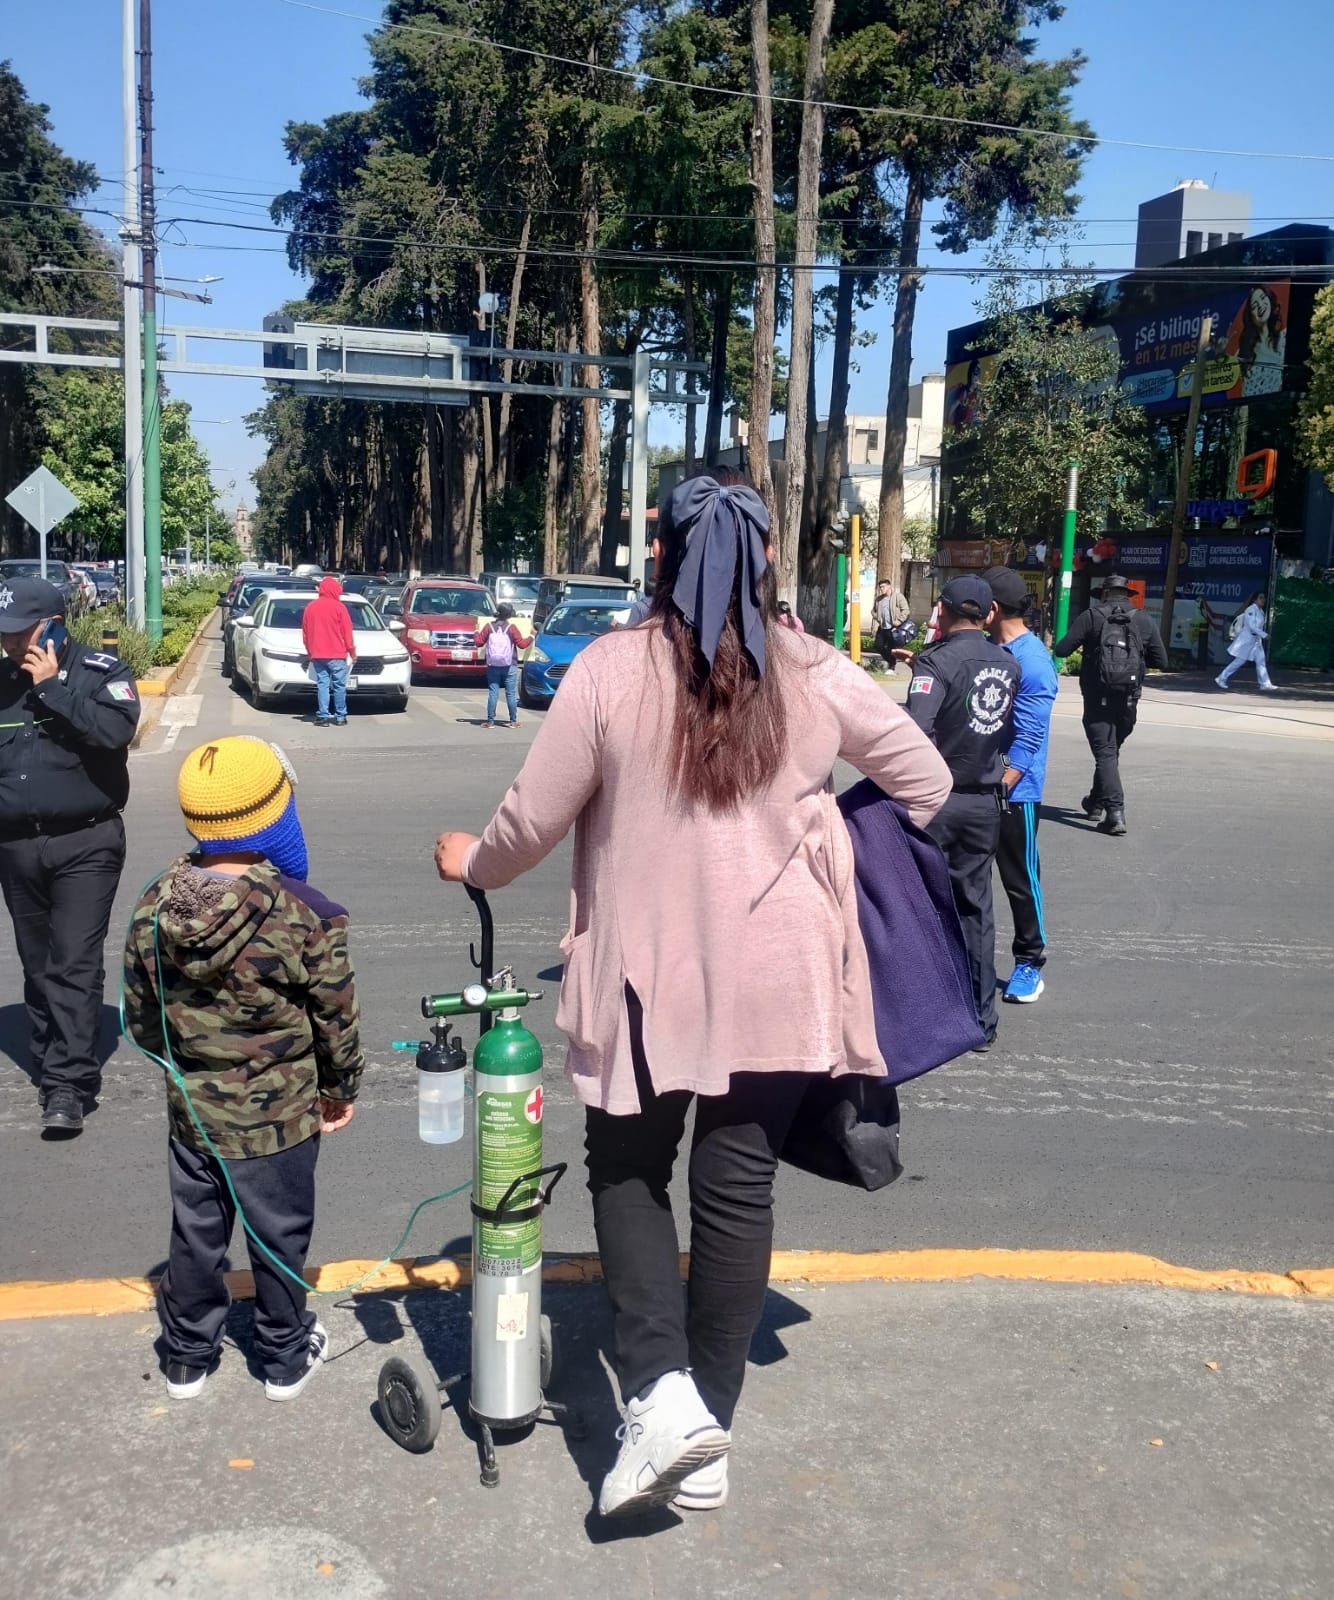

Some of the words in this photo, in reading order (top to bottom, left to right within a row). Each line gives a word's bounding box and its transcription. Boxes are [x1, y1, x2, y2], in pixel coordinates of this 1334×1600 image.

[1135, 322, 1156, 350] ¡Sé
[1135, 349, 1150, 365] en
[1154, 344, 1168, 361] 12
[1209, 545, 1248, 555] EXPERIENCIAS
[1120, 556, 1161, 565] PERSONALIZADOS
[1208, 555, 1236, 565] GRUPALES
[1191, 582, 1204, 594] 722
[1206, 583, 1219, 596] 711
[1220, 584, 1241, 597] 4110
